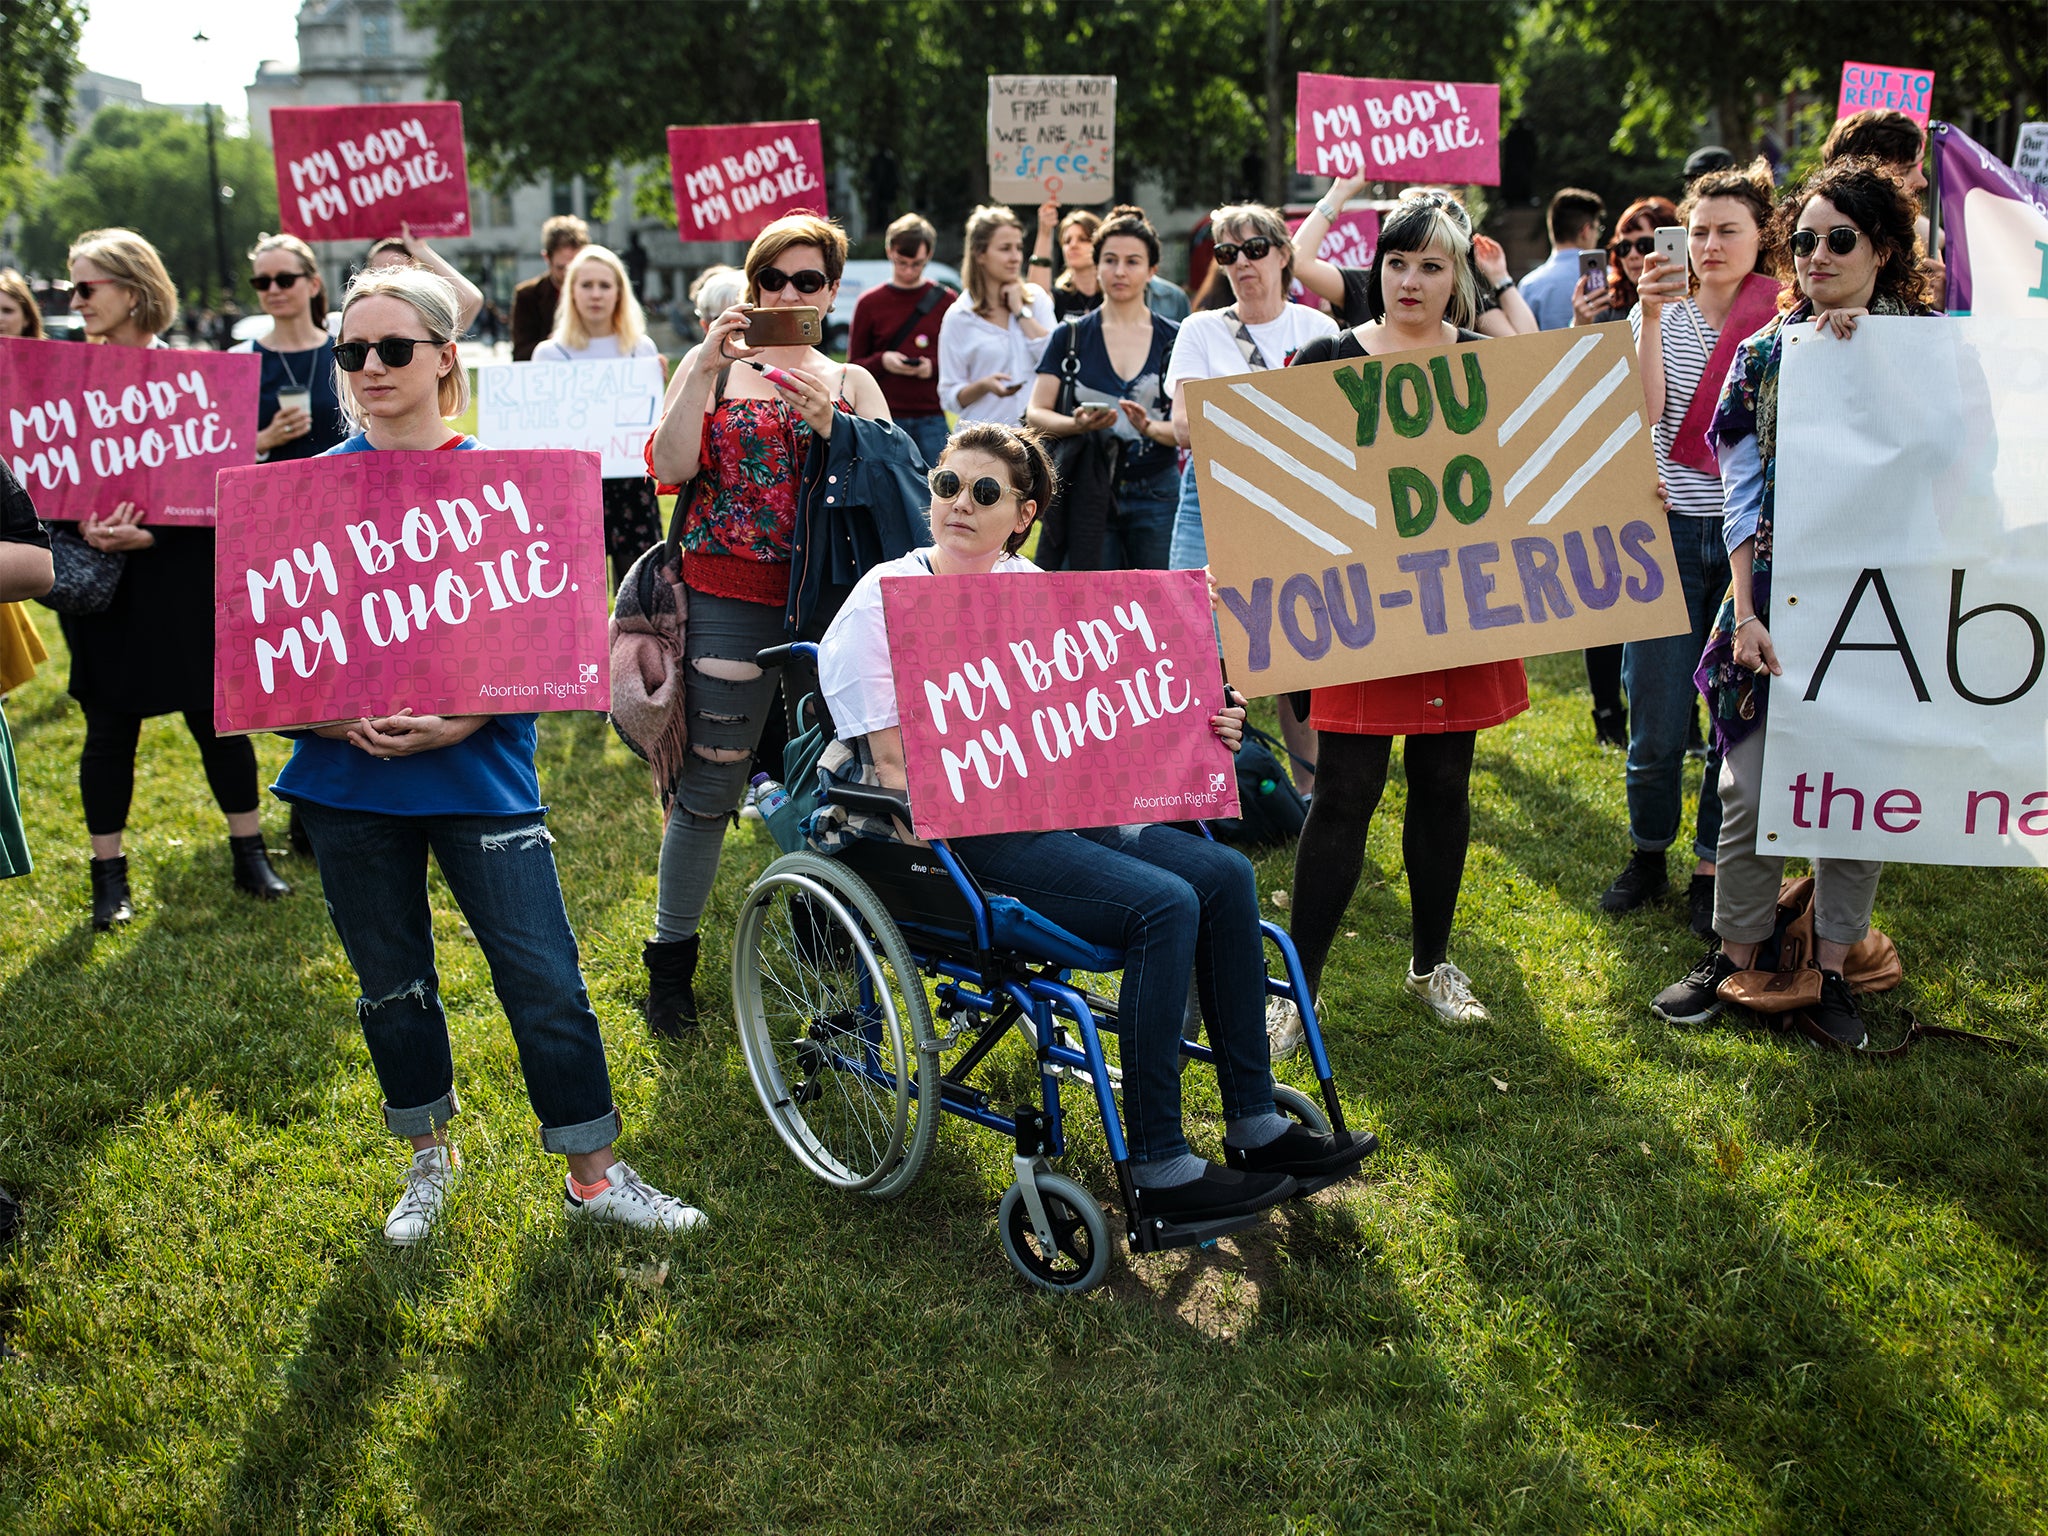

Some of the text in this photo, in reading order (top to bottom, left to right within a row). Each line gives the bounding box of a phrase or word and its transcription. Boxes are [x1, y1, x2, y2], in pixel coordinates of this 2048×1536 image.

[994, 79, 1109, 98] WE ARE NOT
[1010, 99, 1104, 122] FREE UNTIL
[1312, 83, 1467, 142] MY BODY.
[1845, 67, 1931, 94] CUT TO
[1845, 87, 1926, 113] REPEAL
[289, 118, 435, 192] MY BODY.
[994, 123, 1108, 143] WE ARE ALL
[1015, 145, 1088, 176] free
[1316, 115, 1484, 174] MY CHOICE.
[297, 150, 454, 227] MY CHOICE.
[685, 136, 803, 200] MY BODY.
[691, 163, 820, 230] MY CHOICE.
[10, 370, 217, 448] MY BODY.
[485, 361, 647, 407] REPEAL
[1332, 351, 1488, 447] YOU
[486, 402, 560, 431] THE
[12, 412, 238, 490] MY CHOICE.
[1388, 454, 1493, 539] DO
[246, 479, 544, 624] MY BODY.
[255, 541, 579, 694] MY CHOICE.
[1217, 520, 1665, 673] YOU-TERUS
[924, 600, 1168, 735] MY BODY.
[1802, 568, 2046, 706] Ab
[479, 682, 587, 699] Abortion Rights
[941, 659, 1201, 804] MY CHOICE.
[1133, 792, 1218, 809] Abortion Rights
[1789, 772, 2048, 836] the na
